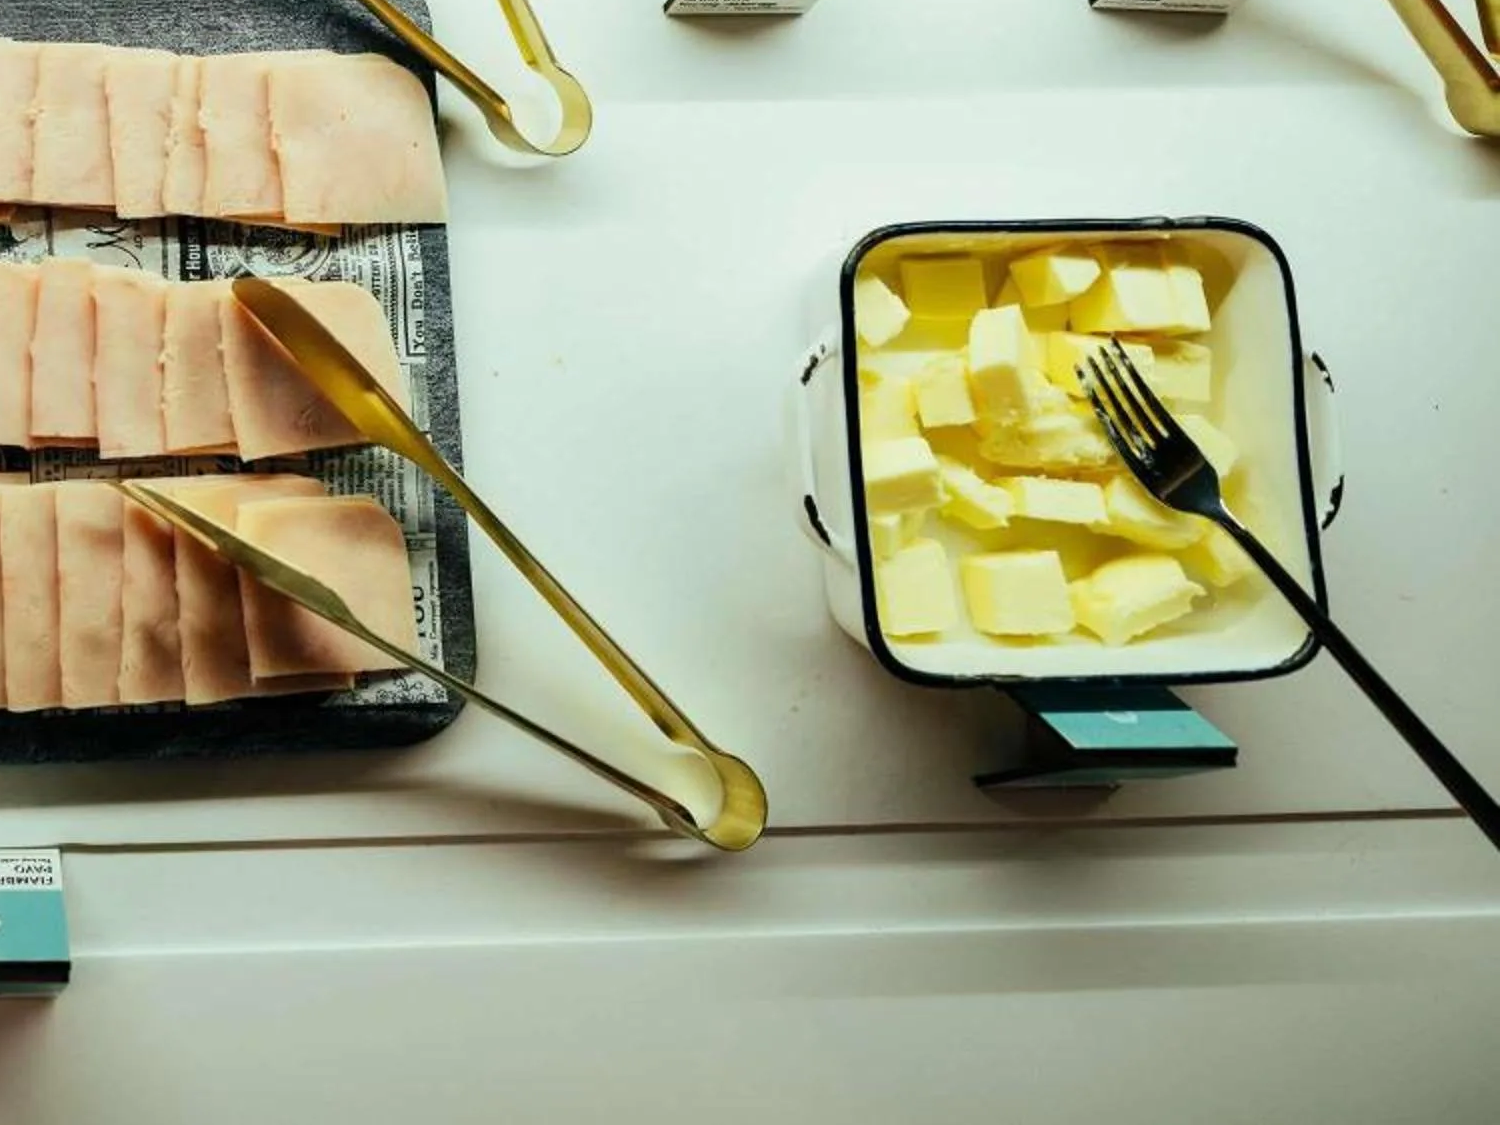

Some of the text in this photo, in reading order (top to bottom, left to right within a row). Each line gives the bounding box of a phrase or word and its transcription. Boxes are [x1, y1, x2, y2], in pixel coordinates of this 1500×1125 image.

[410, 271, 424, 310] Don't
[411, 320, 424, 351] You
[13, 865, 53, 874] PAVO
